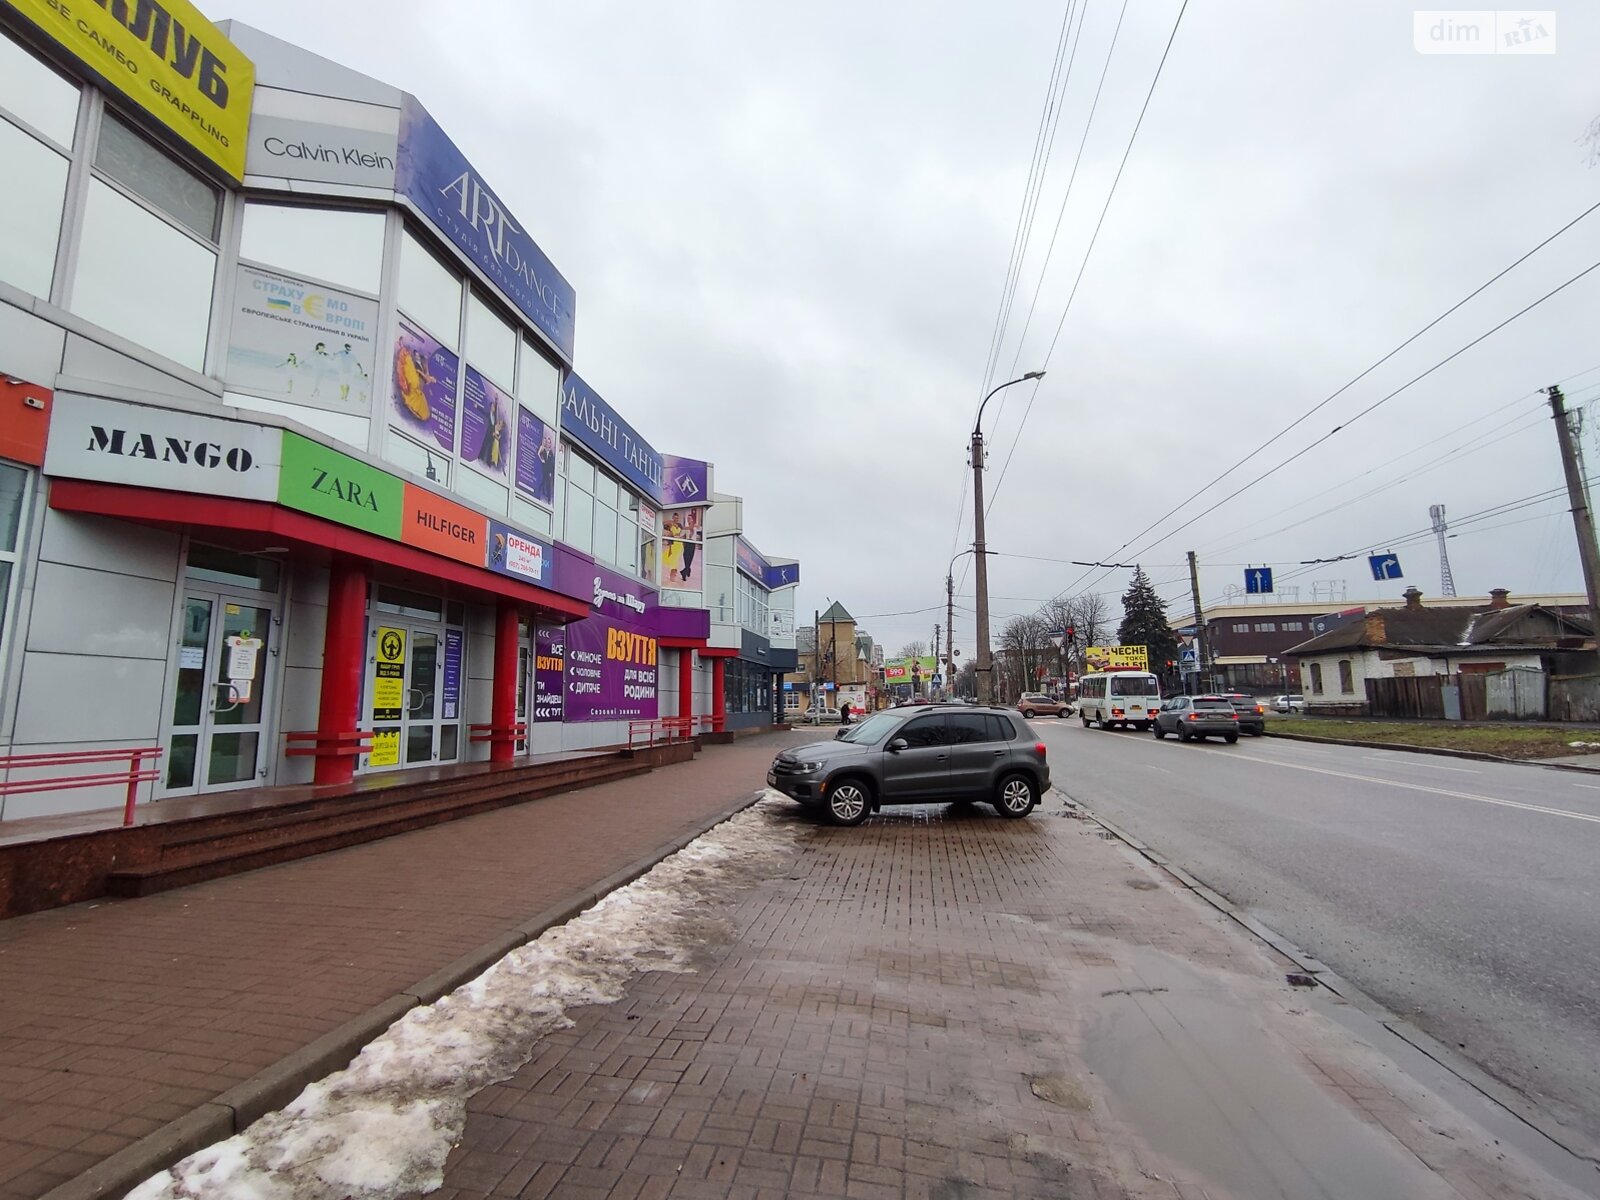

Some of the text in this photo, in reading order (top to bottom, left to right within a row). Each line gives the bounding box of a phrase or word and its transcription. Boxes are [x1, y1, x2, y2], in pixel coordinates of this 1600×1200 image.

[76, 19, 138, 74] САМБО
[149, 78, 230, 148] GRAPPLING
[264, 137, 395, 171] Calvin Klein
[438, 171, 520, 269] ART
[506, 240, 561, 319] DANCE
[86, 425, 253, 472] MANGO
[311, 467, 379, 512] ZARA
[416, 509, 476, 545] HILFIGER
[508, 537, 541, 558] ОРЕНДА
[536, 656, 563, 671] ВЗУТТЯ
[551, 643, 563, 656] ВСЕ
[576, 651, 602, 665] ЖІНОЧЕ
[607, 627, 657, 666] ВЗУТТЯ
[1111, 646, 1146, 656] ЧЕСНЕ
[575, 681, 601, 695] ДИТЯЧЕ
[624, 669, 637, 681] ДЛЯ
[623, 685, 655, 700] РОДИНИ
